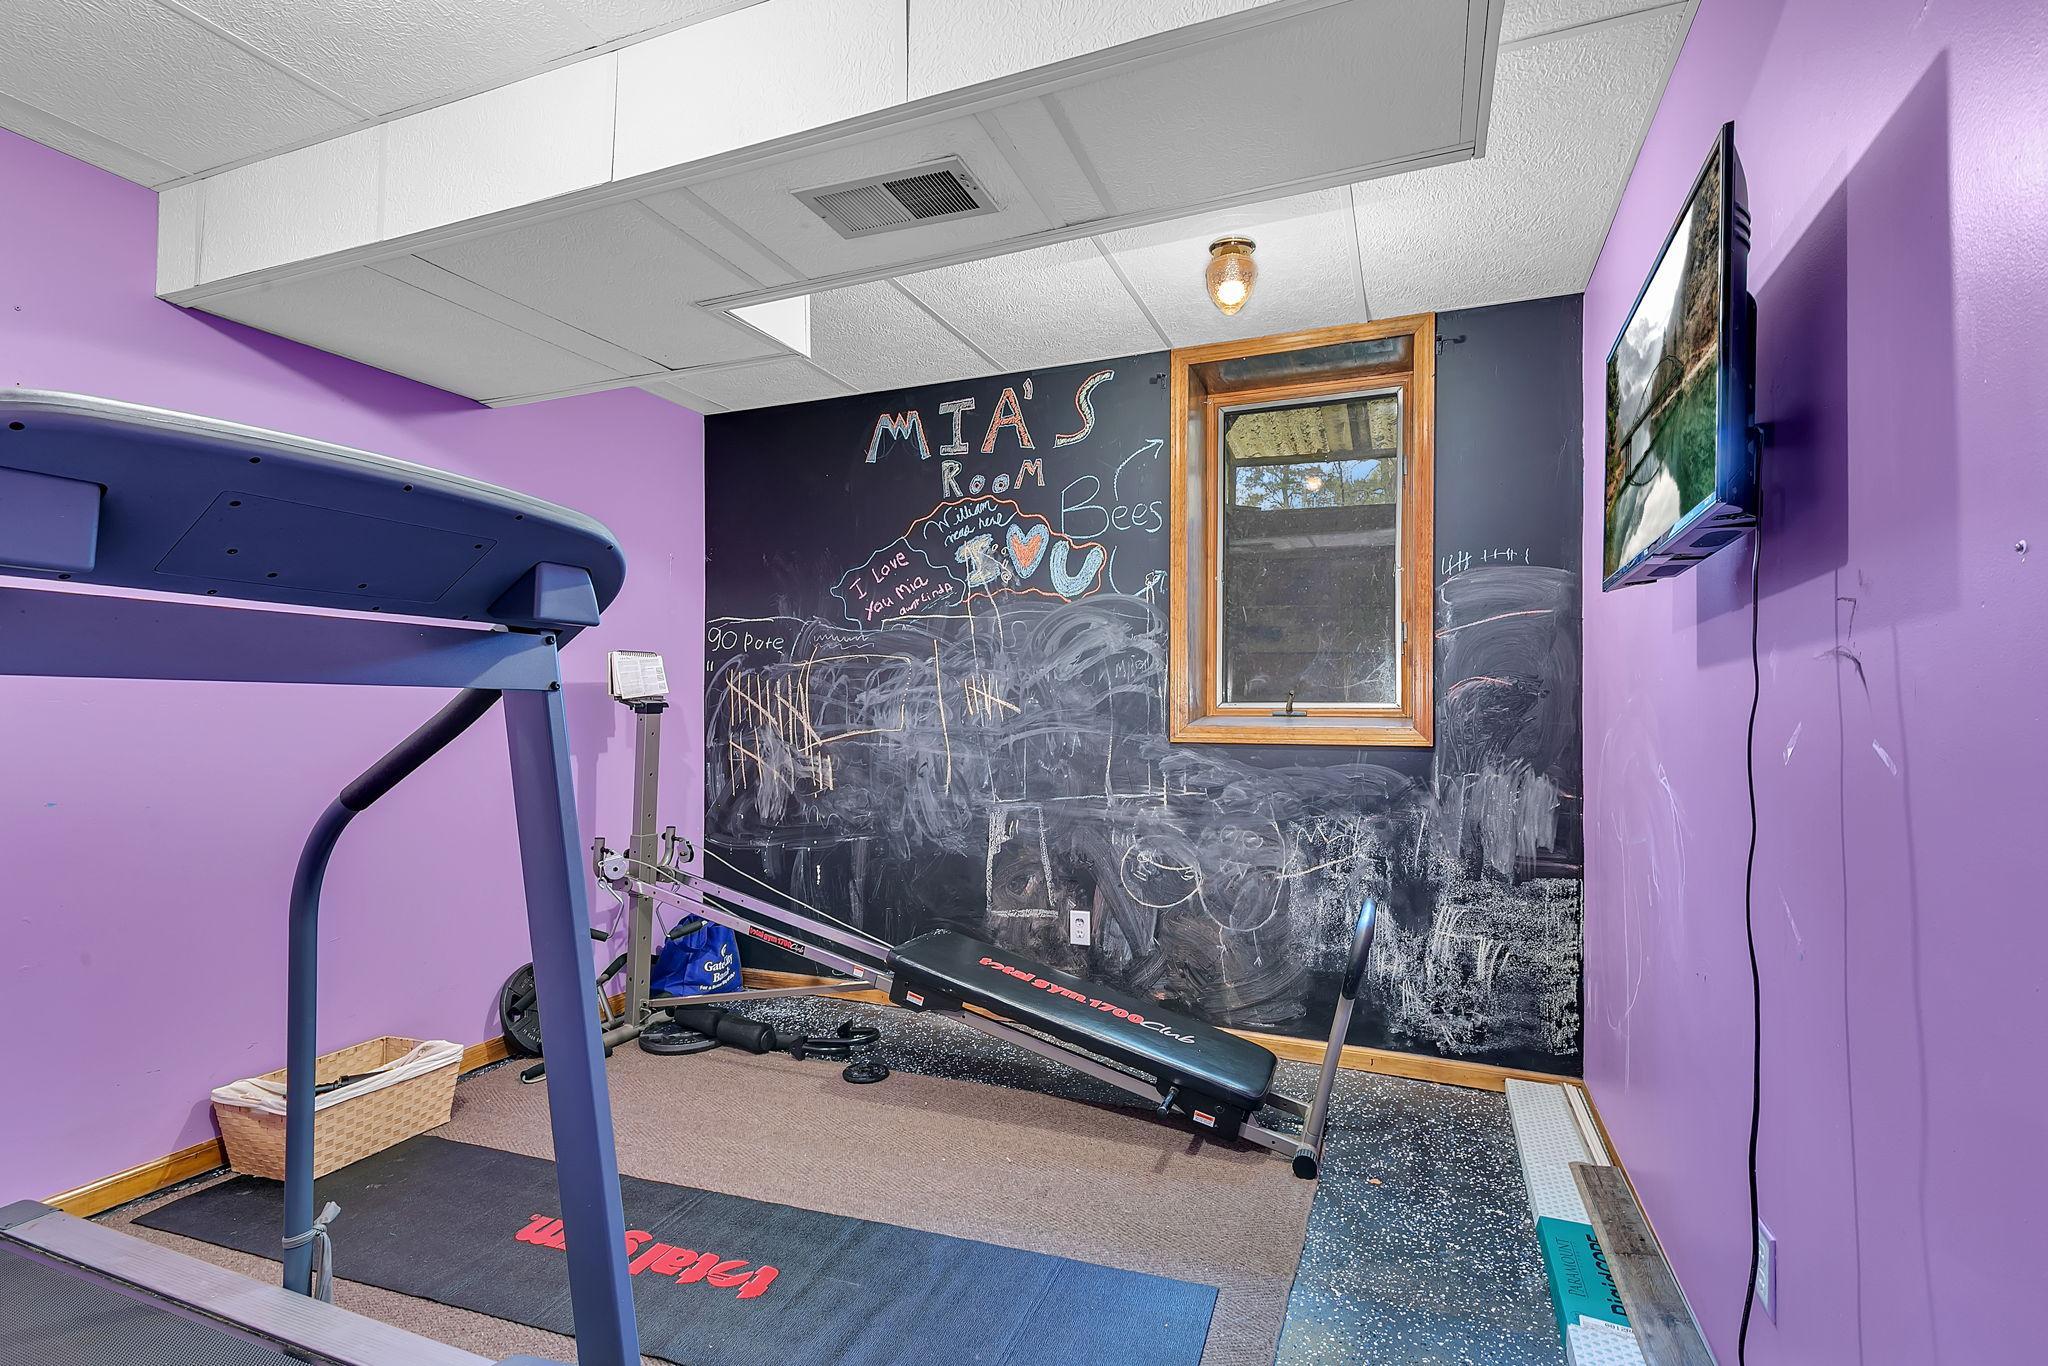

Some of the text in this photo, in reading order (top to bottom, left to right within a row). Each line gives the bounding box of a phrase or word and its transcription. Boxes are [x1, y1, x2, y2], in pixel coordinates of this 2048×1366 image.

[865, 369, 1114, 463] MIA'S
[1061, 475, 1164, 539] Bees
[849, 551, 910, 600] I Love
[895, 574, 929, 600] Mia
[978, 956, 1035, 983] total
[1555, 1236, 1588, 1298] PARAMOUNT
